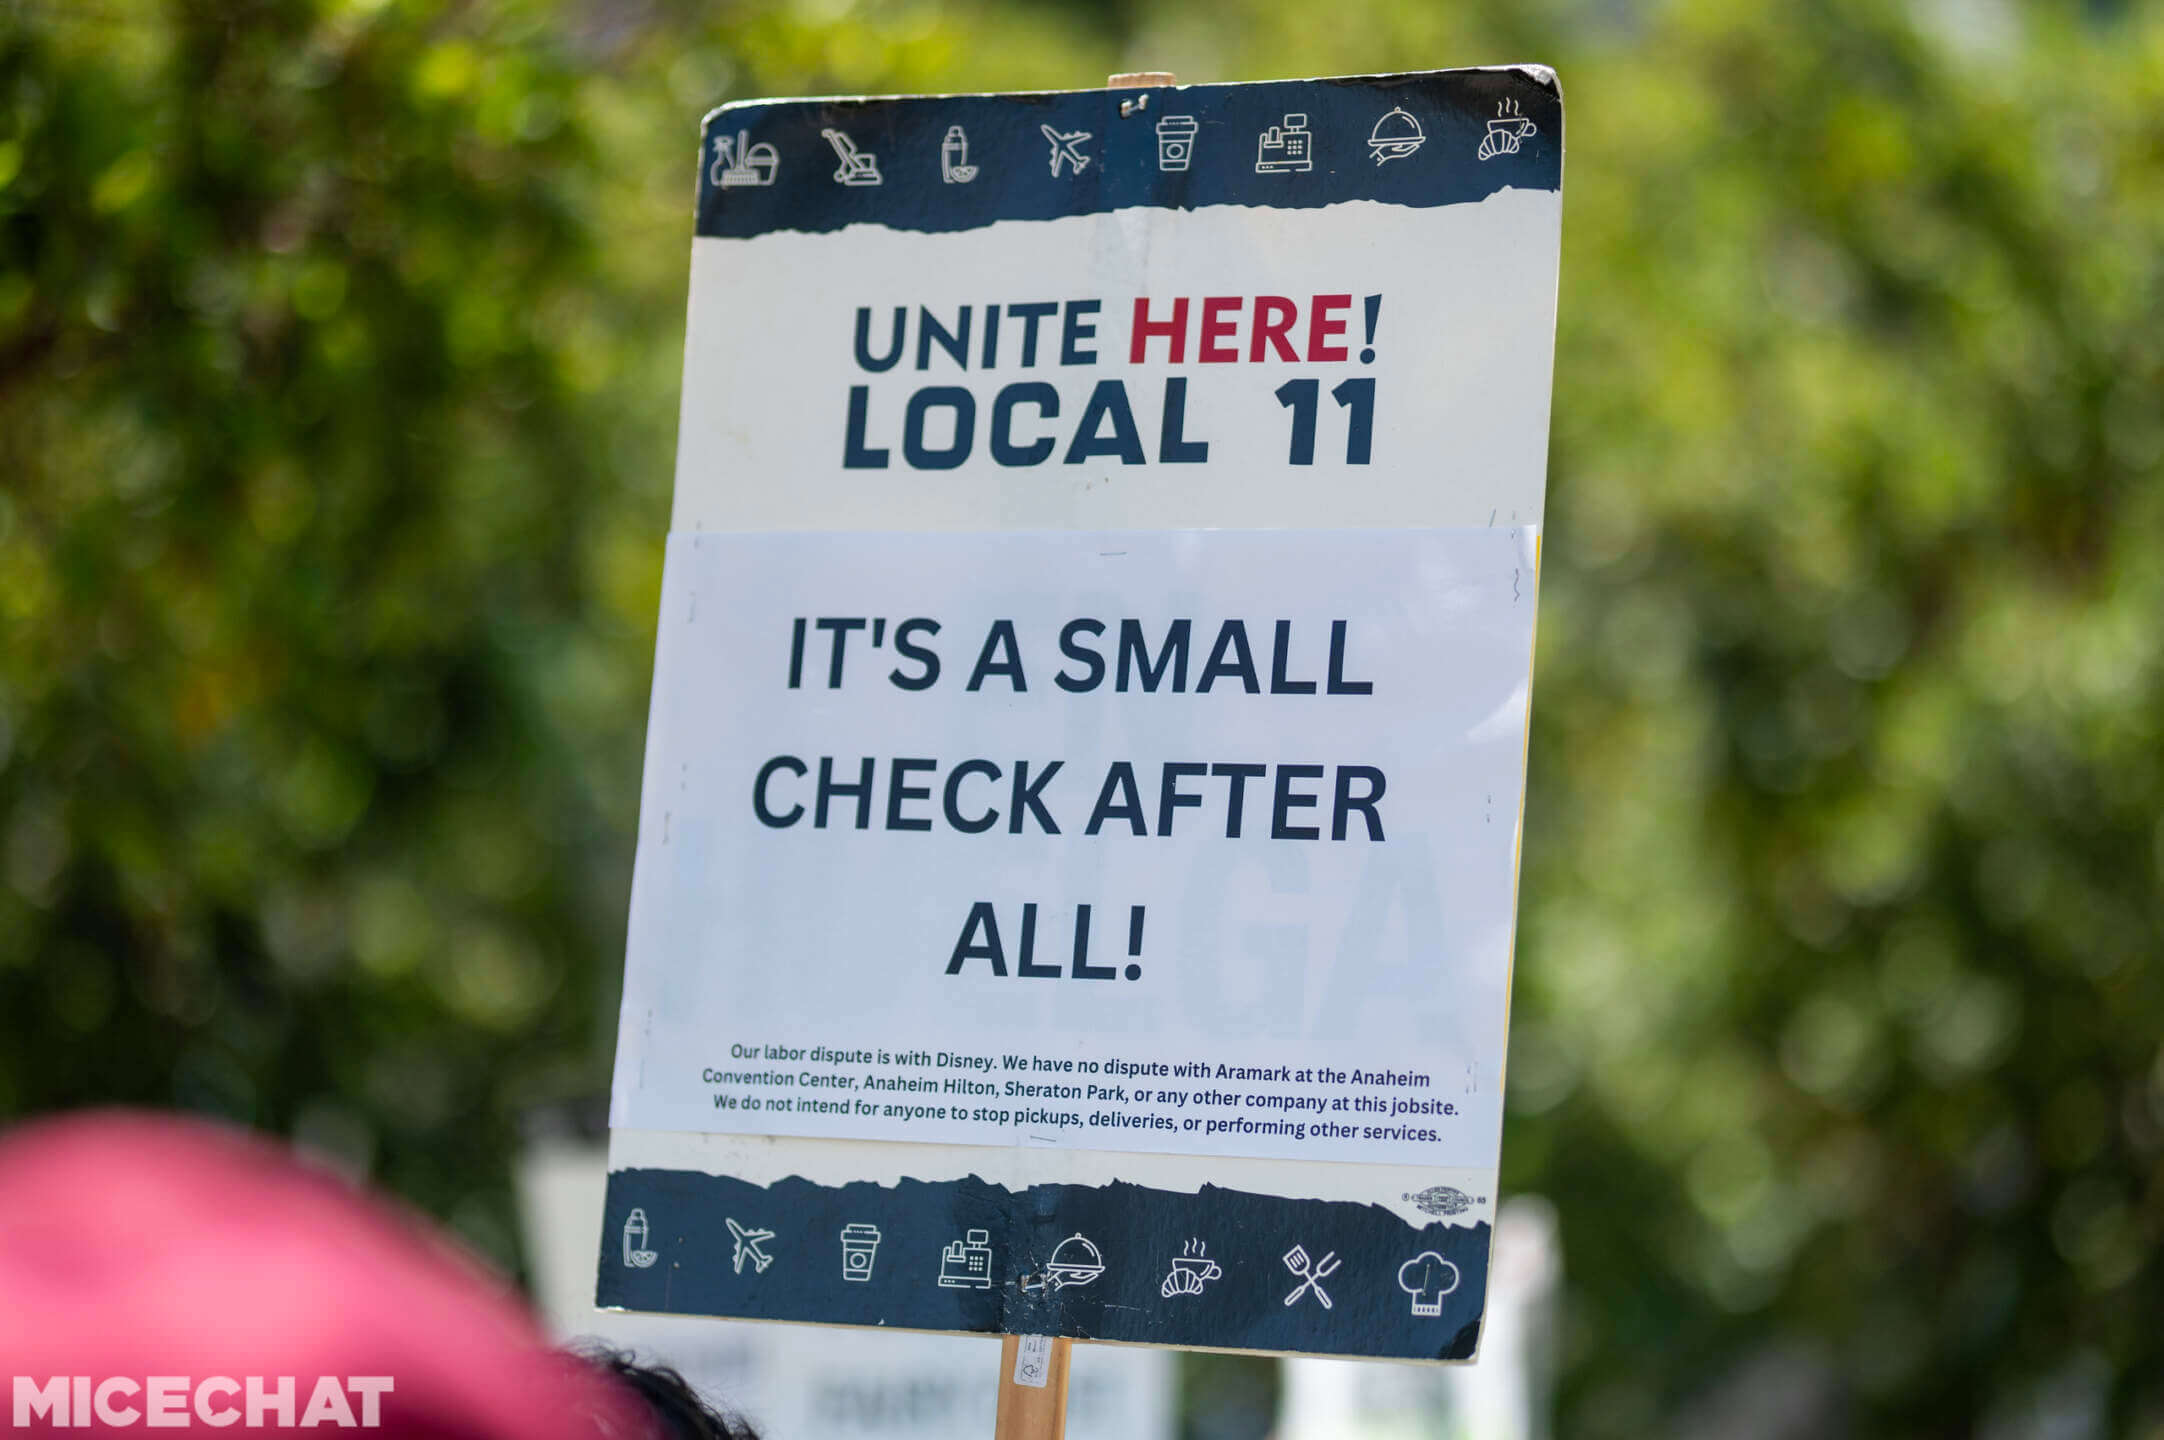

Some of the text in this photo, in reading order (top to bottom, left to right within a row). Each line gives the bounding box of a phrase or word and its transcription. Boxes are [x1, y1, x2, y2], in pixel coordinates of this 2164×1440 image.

[855, 293, 1382, 373] UNITE HERE!
[843, 377, 1376, 470] LOCAL 11
[789, 617, 1374, 696] IT'S A SMALL
[753, 755, 1387, 842] CHECK AFTER
[945, 902, 1146, 981] ALL!
[703, 1068, 1459, 1118] Convention Center, Anaheim Hilton, Sheraton Park, or any other company at this jobsite.
[731, 1043, 1430, 1088] Our labor dispute is with Disney. We have no dispute with Aramark at the Anaheim
[714, 1094, 1442, 1142] We do not intend for anyone to stop pickups, deliveries, or performing other services.
